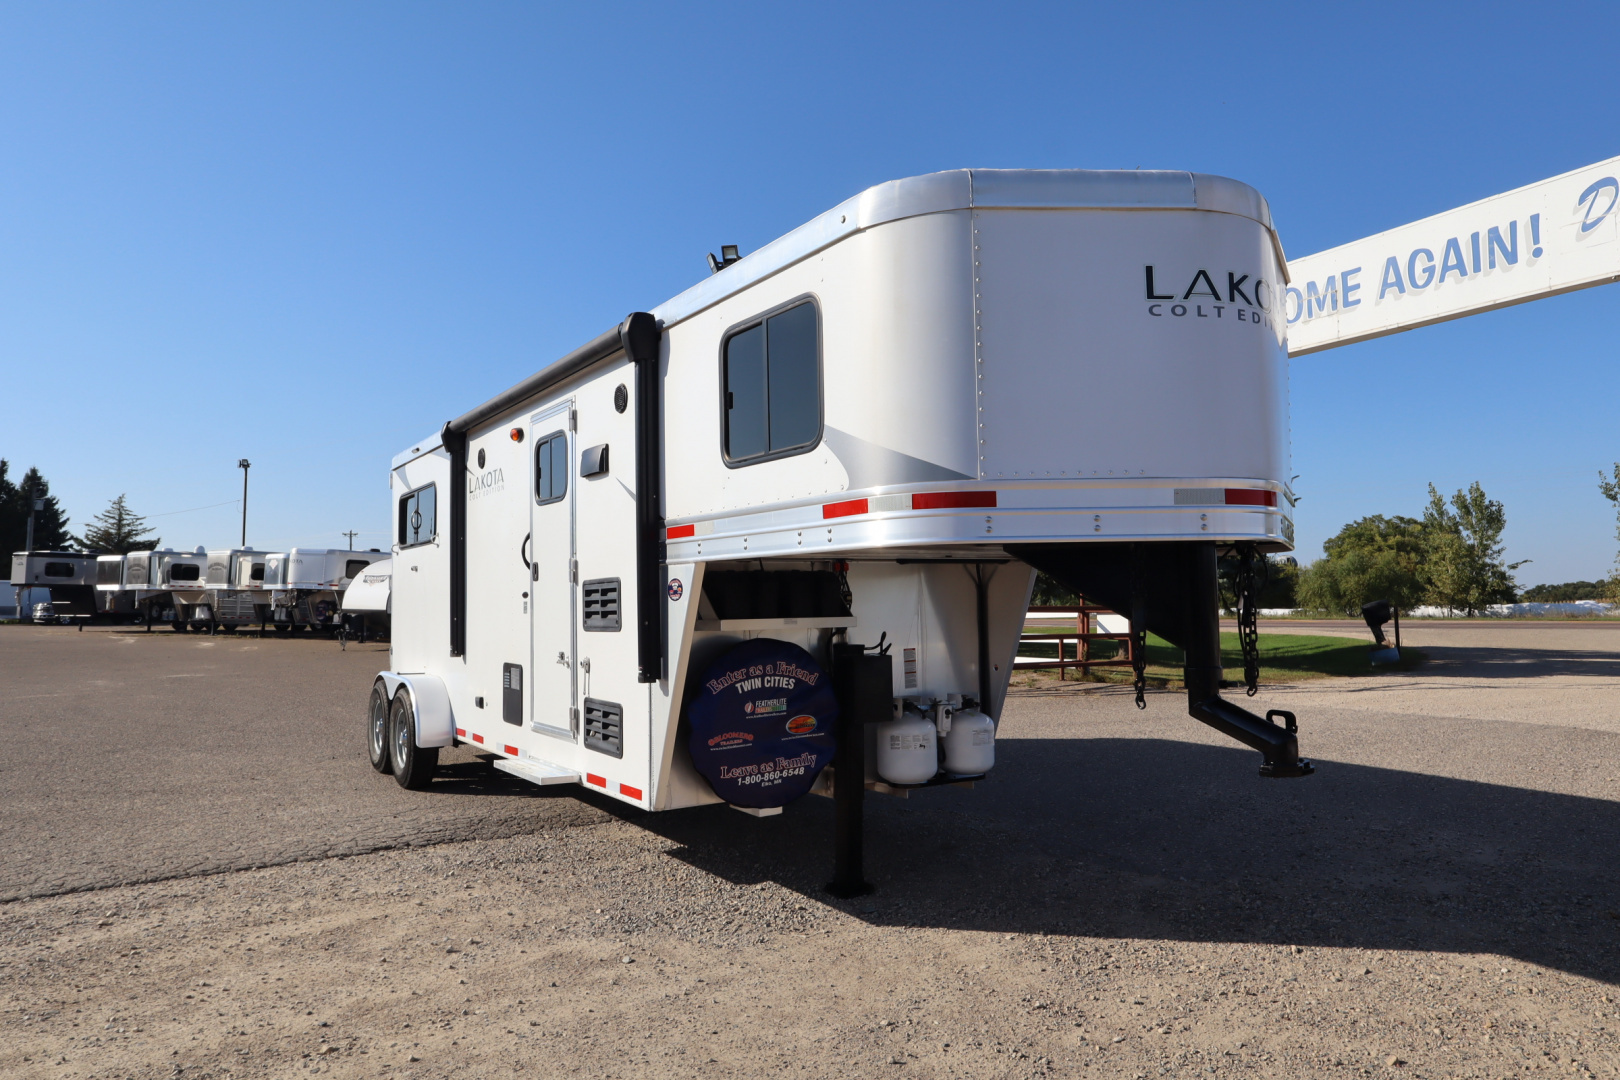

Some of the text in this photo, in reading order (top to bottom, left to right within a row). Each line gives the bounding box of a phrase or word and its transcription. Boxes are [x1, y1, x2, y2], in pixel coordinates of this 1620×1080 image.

[1379, 213, 1544, 300] AGAIN!
[1145, 265, 1273, 314] LAKO
[1148, 304, 1225, 318] COLT
[468, 467, 505, 494] LAKOTA
[706, 661, 819, 695] Enter as a Friend
[735, 676, 796, 694] TWIN CITIES
[720, 752, 817, 779] Leave as Family
[737, 766, 805, 786] 1-800-860-6548
